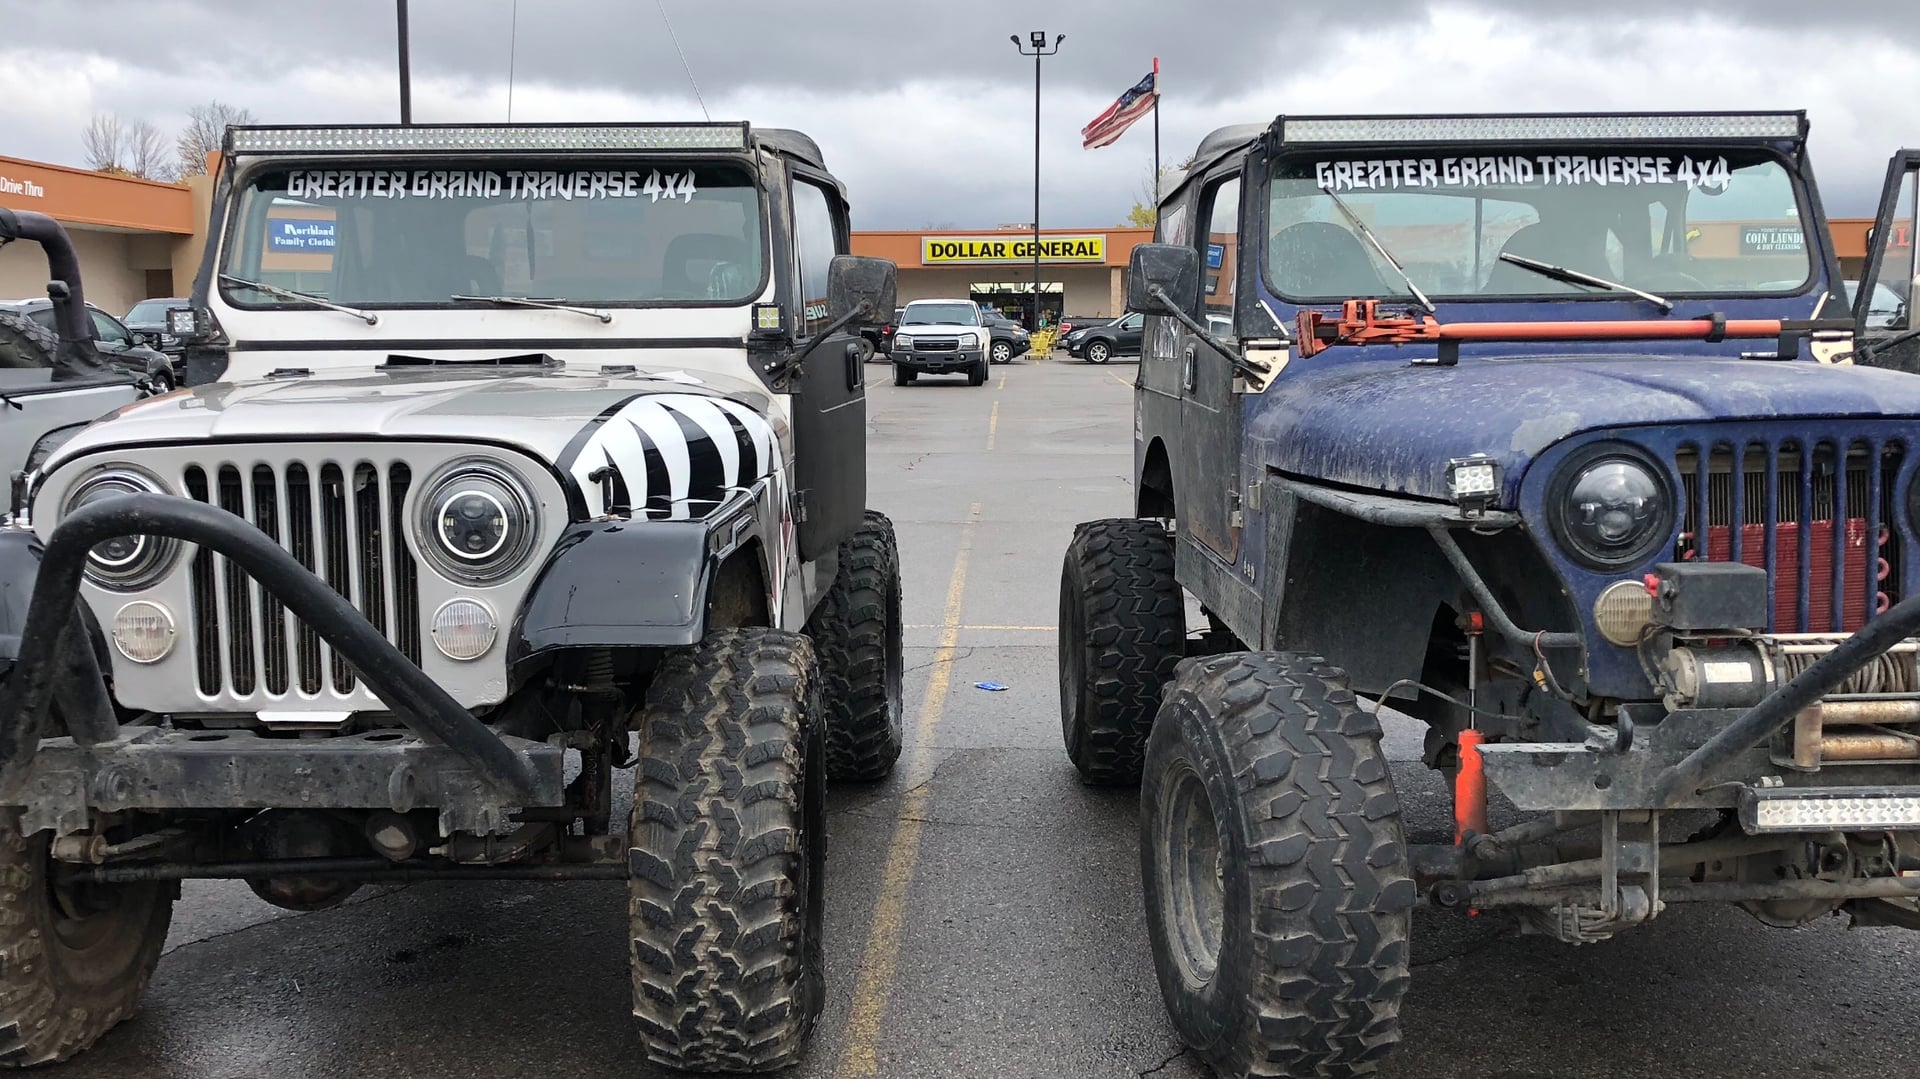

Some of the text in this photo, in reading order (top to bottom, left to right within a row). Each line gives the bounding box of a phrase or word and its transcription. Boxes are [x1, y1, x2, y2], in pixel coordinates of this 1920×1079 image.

[1315, 158, 1437, 191] GREATER
[1443, 156, 1534, 188] GRAND
[1537, 155, 1674, 186] TRAVERSE
[0, 176, 44, 198] Drive Thru
[287, 170, 407, 200] GREATER
[412, 170, 500, 200] GRAND
[506, 170, 641, 201] TRAVERSE
[284, 223, 334, 236] Northland
[1745, 232, 1768, 244] COIN
[275, 236, 336, 247] Family Clothi
[931, 241, 1099, 258] DOLLAR GENERAL
